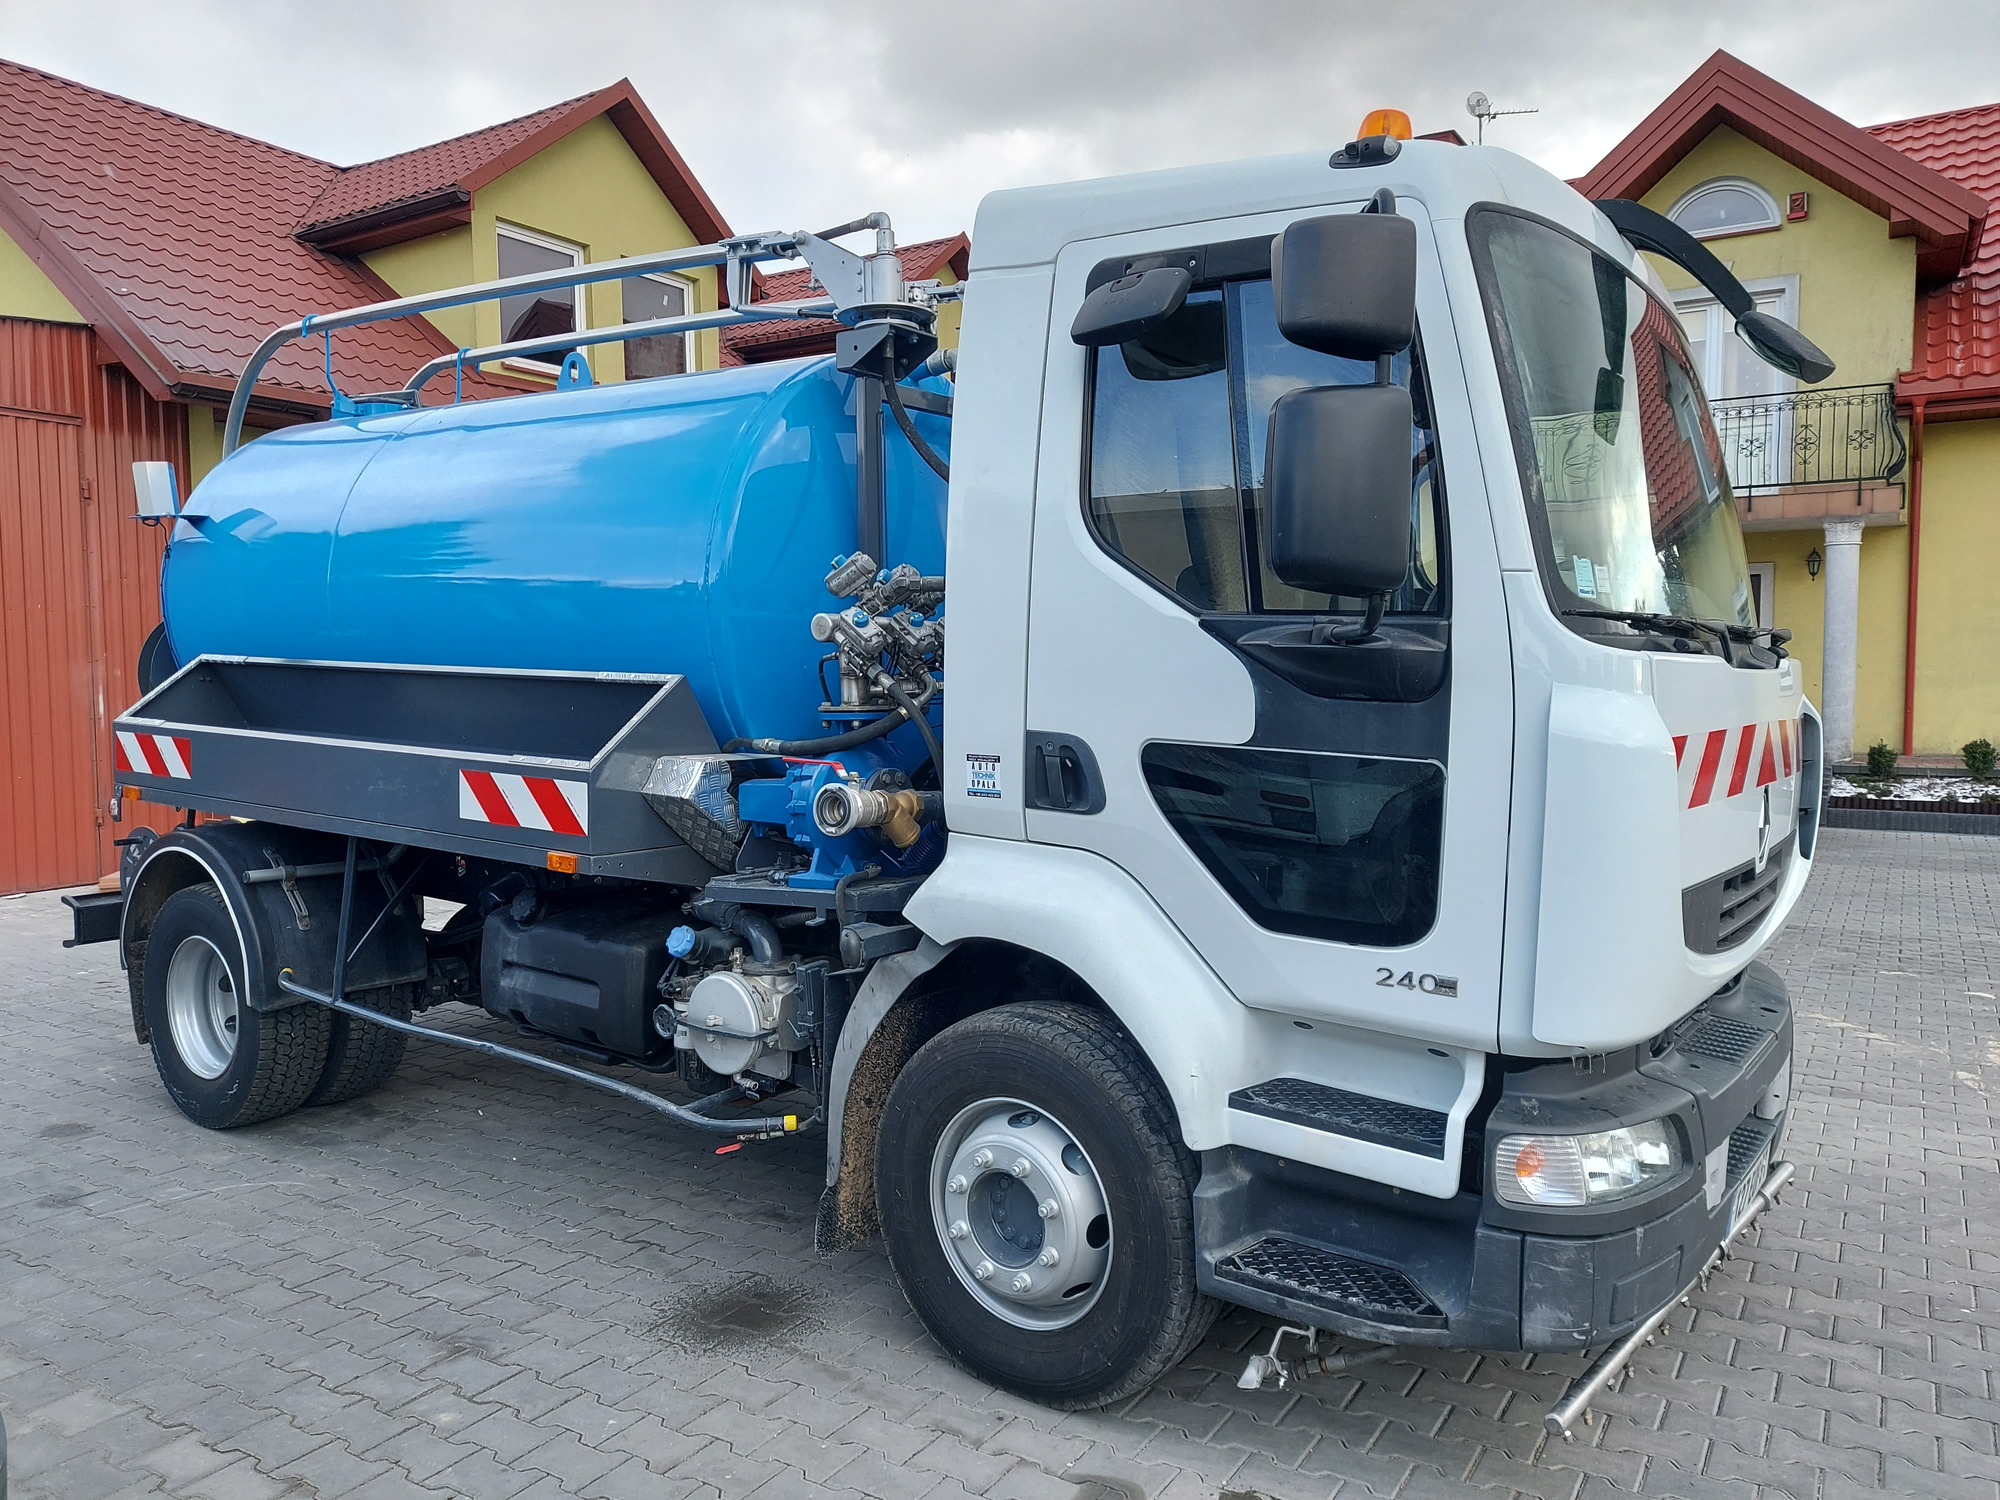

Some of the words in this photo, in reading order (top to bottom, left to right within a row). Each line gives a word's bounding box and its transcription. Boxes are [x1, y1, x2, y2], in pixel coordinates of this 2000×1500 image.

[972, 762, 995, 771] AUTO
[971, 771, 996, 780] TECHNIK
[972, 779, 996, 789] OPALA
[1376, 967, 1440, 995] 240
